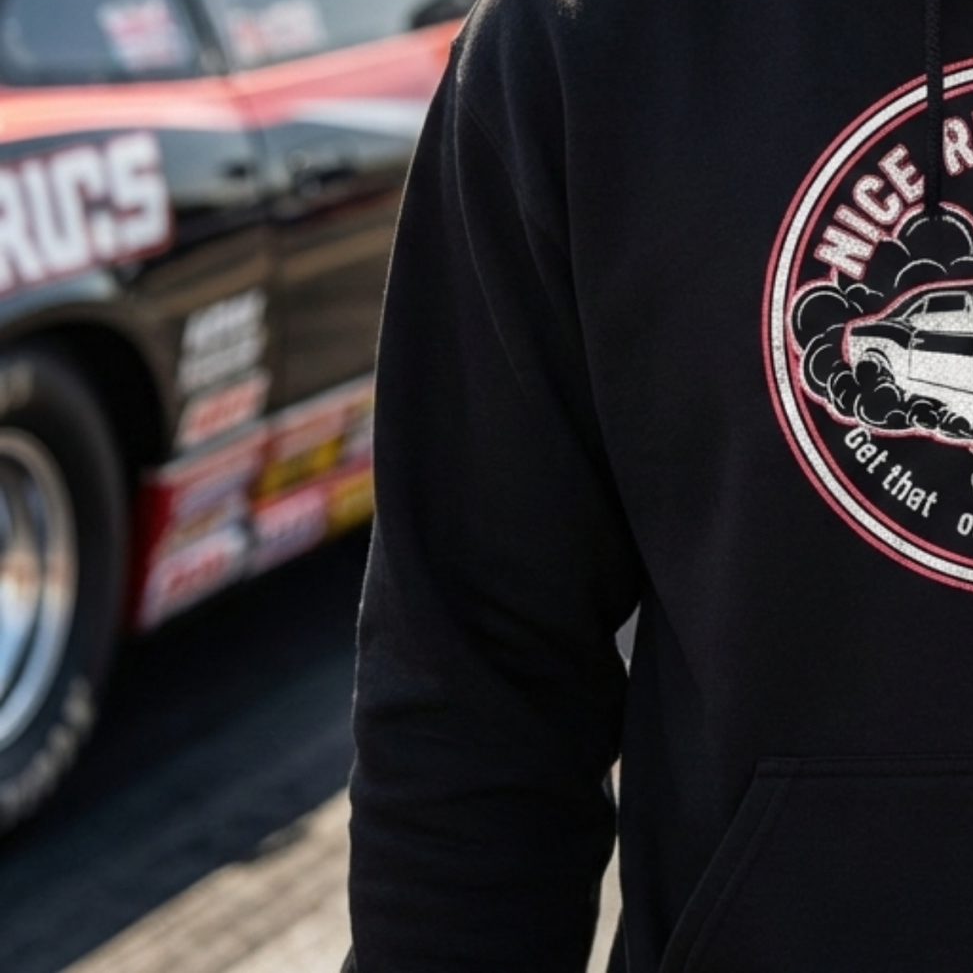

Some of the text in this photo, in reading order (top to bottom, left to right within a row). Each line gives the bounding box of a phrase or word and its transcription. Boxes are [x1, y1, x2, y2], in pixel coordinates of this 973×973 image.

[813, 144, 925, 280] NICE
[844, 427, 888, 474] Get
[882, 464, 938, 518] that
